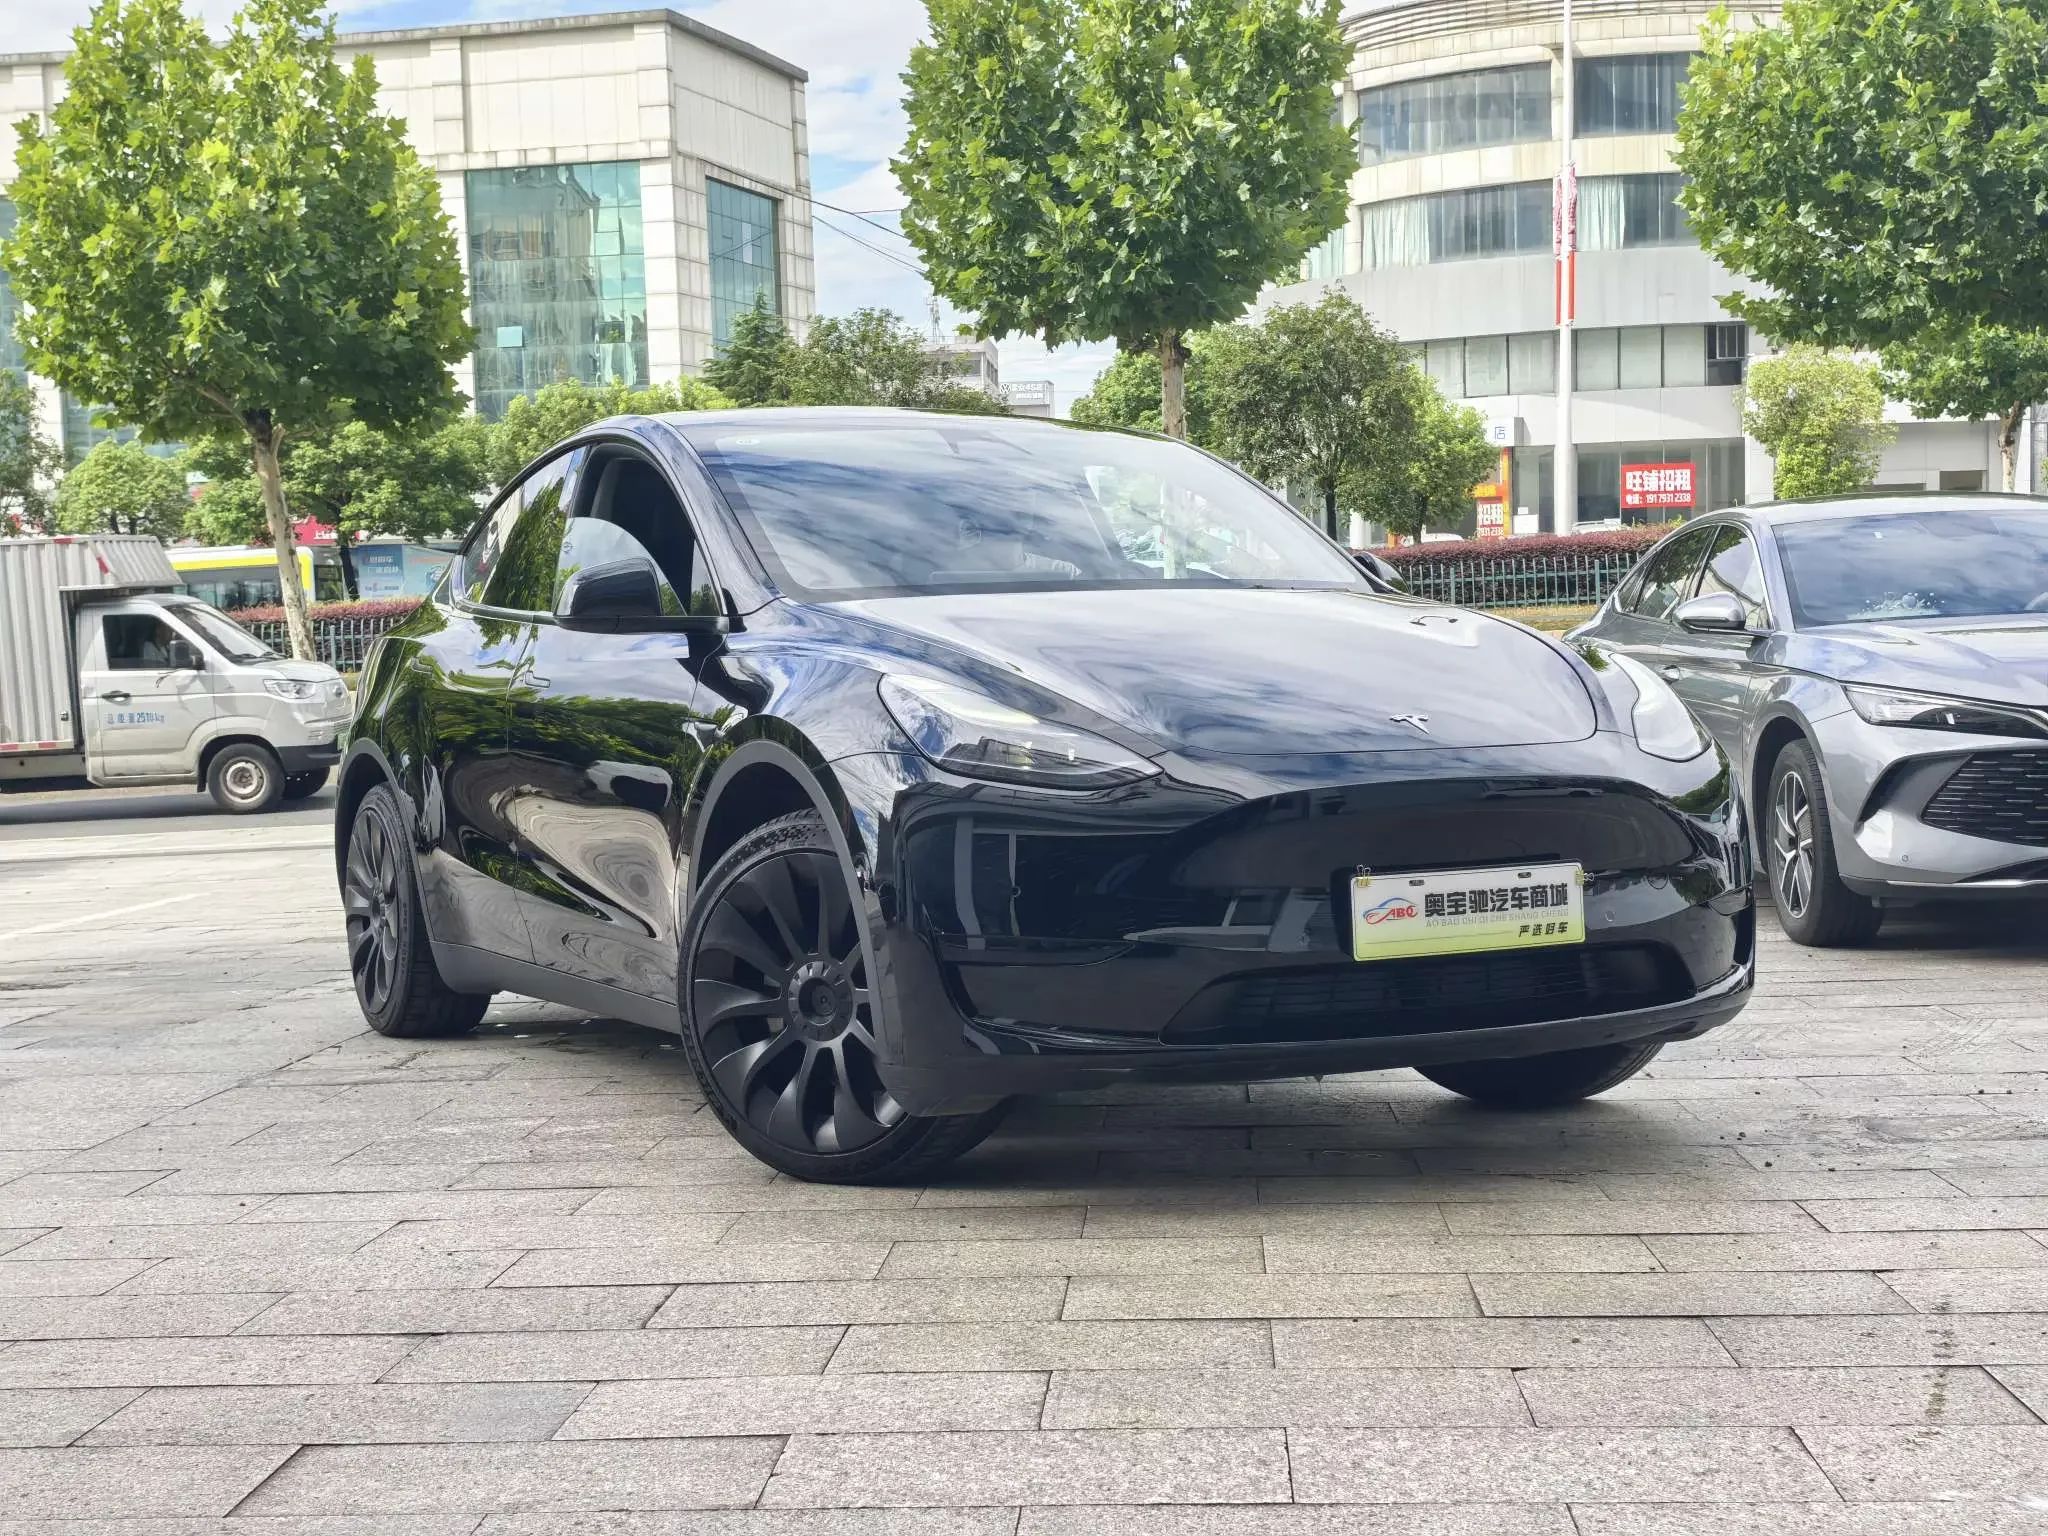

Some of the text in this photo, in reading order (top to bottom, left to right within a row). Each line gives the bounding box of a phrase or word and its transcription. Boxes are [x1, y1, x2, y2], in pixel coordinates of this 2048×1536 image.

[1626, 469, 1691, 492] 旺铺招租
[1424, 883, 1568, 917] 奥宝驰汽车商城
[1518, 921, 1569, 938] 严选好车
